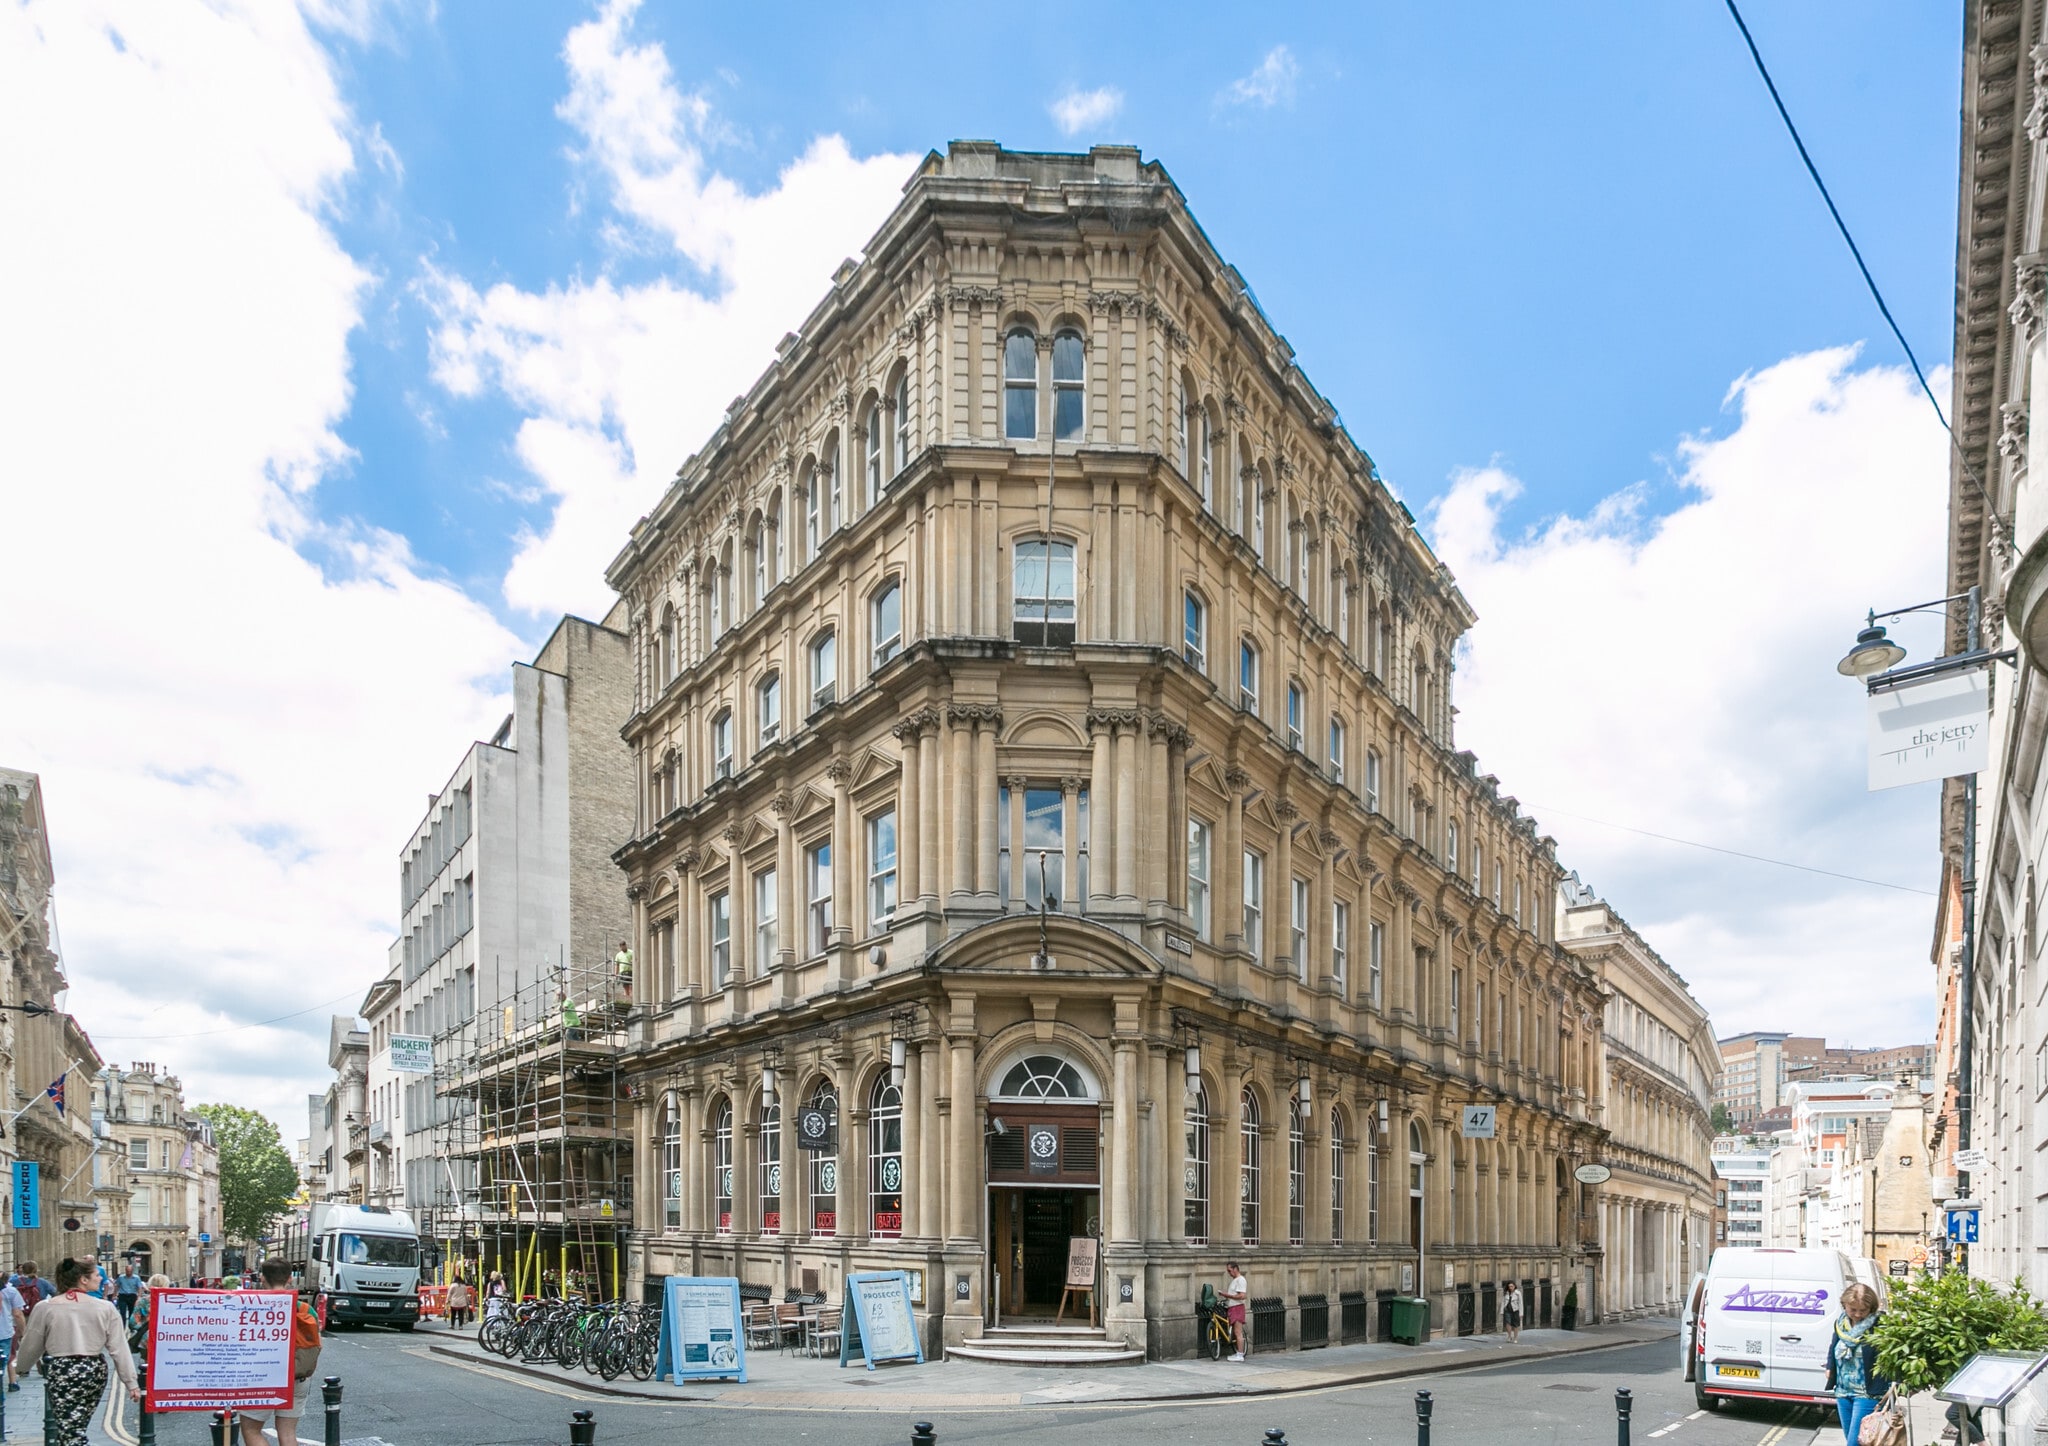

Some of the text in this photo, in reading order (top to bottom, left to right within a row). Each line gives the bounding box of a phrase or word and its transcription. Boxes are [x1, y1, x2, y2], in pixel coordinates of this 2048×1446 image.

[1913, 724, 1979, 745] the jetty
[391, 1039, 429, 1051] HICKERY
[392, 1053, 430, 1062] SCAFFOLDING
[1470, 1113, 1488, 1126] 47
[22, 1163, 30, 1192] NERO
[161, 1293, 290, 1308] Beirut Mezze
[1721, 1284, 1828, 1310] Avanti
[162, 1315, 194, 1325] Lunch
[197, 1316, 228, 1325] Menu
[239, 1311, 286, 1325] £4.99
[158, 1332, 194, 1341] Dinner
[197, 1332, 228, 1341] Menu
[239, 1329, 289, 1341] £14.99
[1721, 1368, 1759, 1377] JU57 AVA
